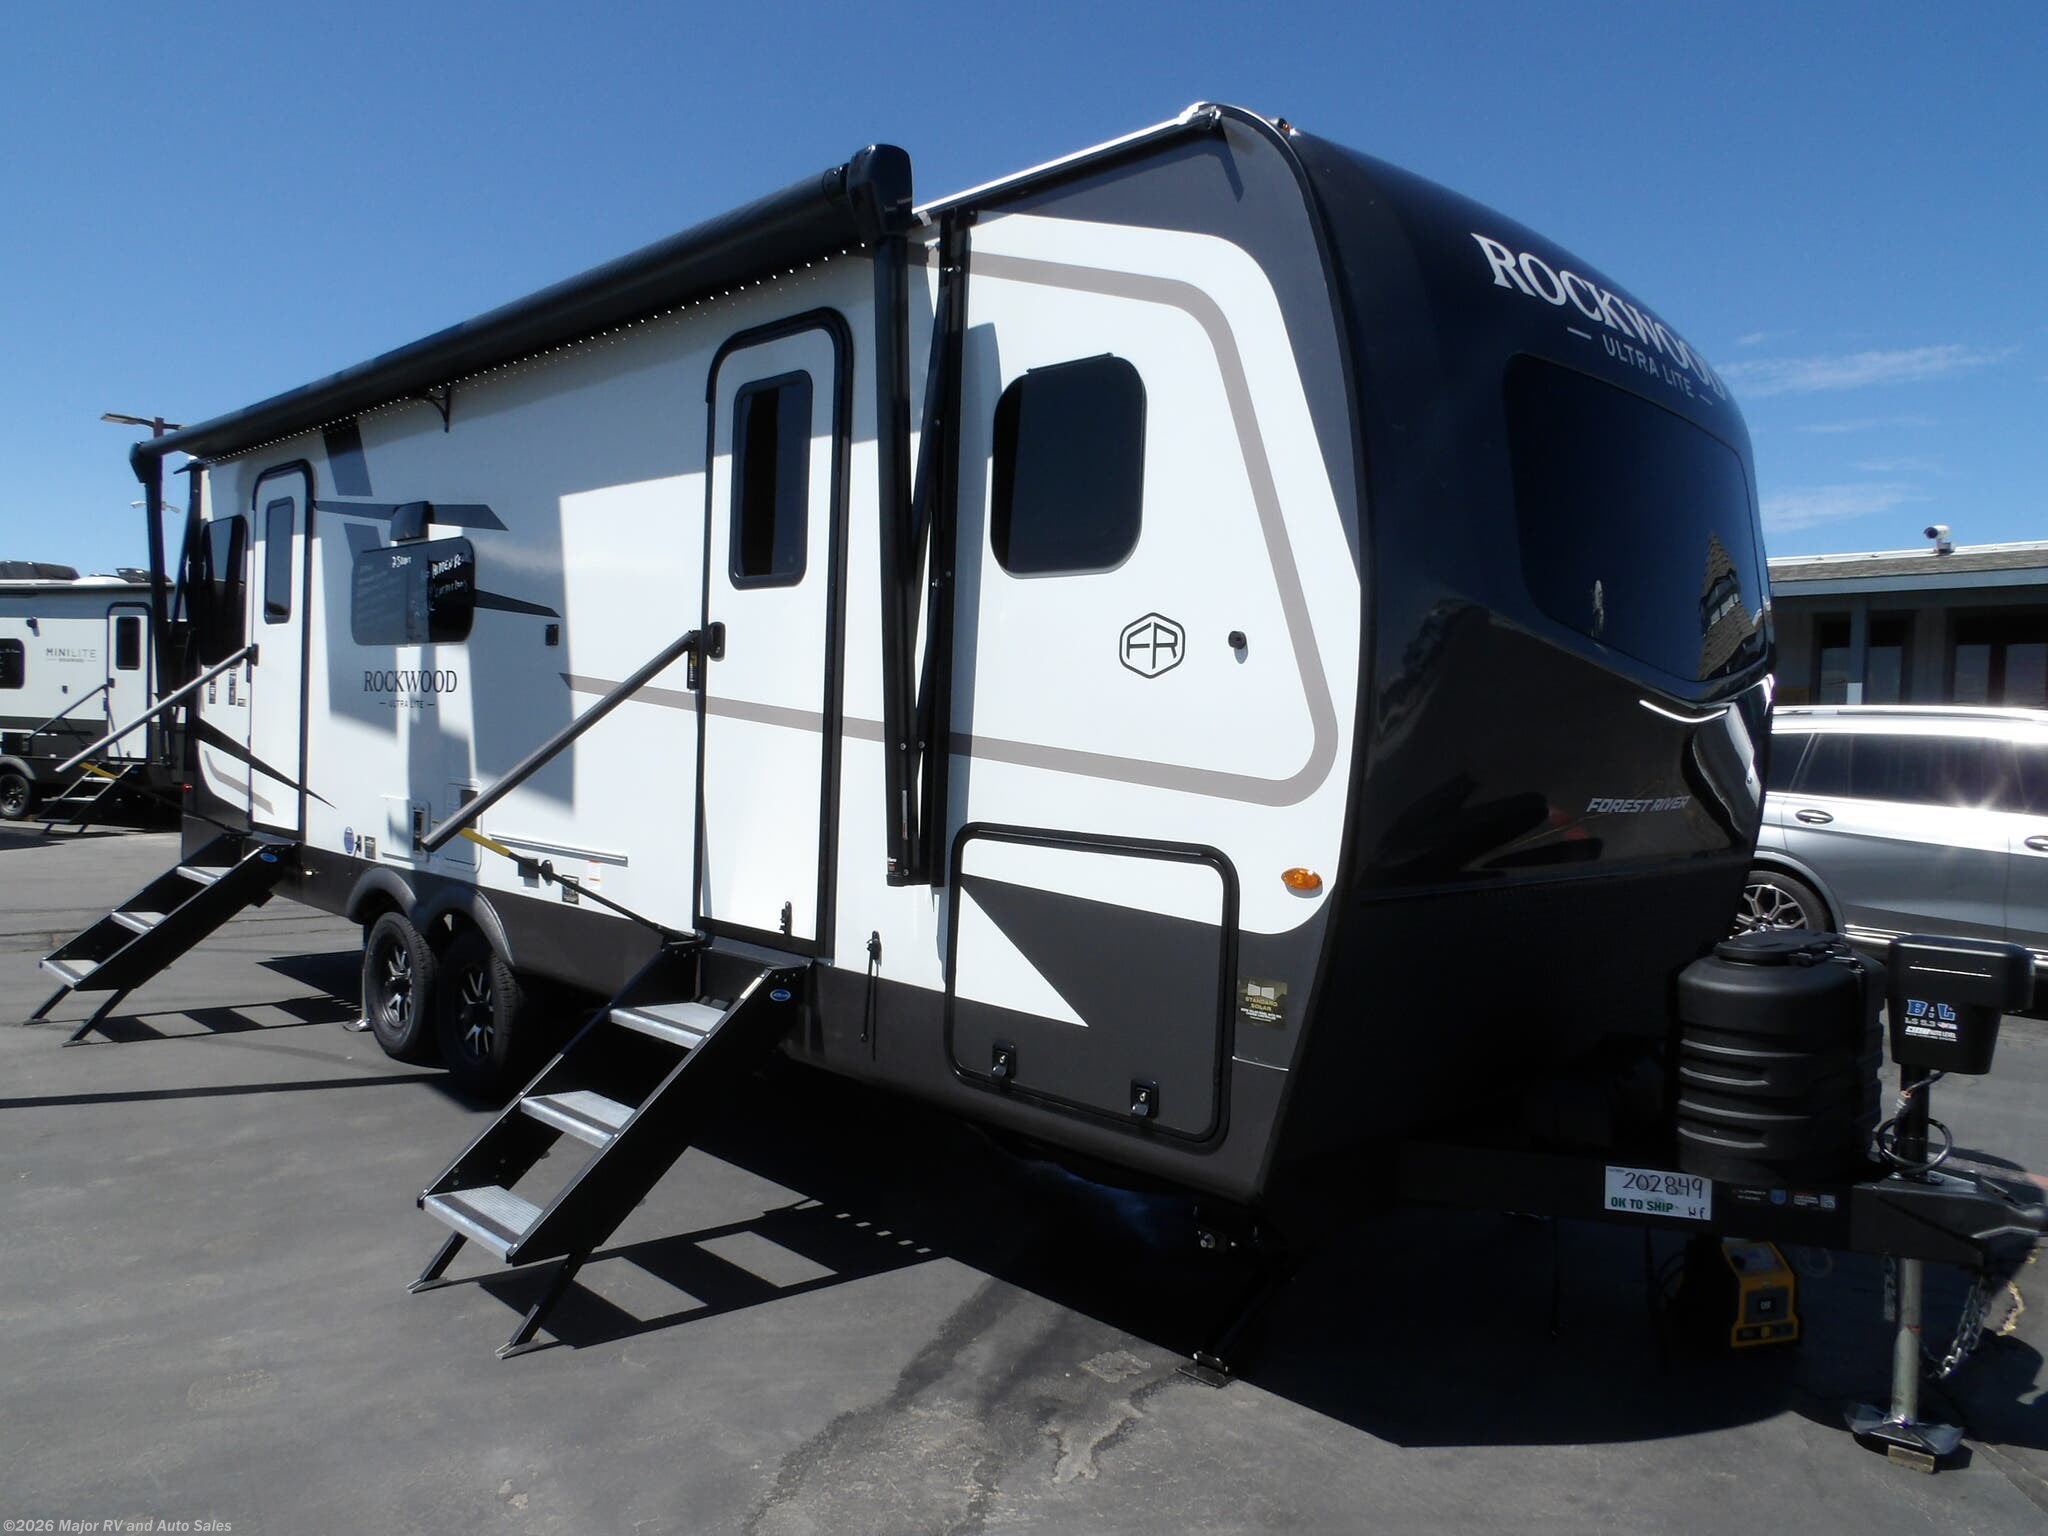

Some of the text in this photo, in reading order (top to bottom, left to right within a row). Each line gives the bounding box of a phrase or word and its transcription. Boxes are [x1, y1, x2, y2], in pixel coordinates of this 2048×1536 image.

[1602, 333, 1695, 398] ULTRA LITE
[363, 670, 457, 693] ROCKWOOD
[1586, 796, 1690, 813] FOREST RIVER
[1251, 1003, 1272, 1013] SOLAR
[1622, 1172, 1703, 1199] 202849
[1611, 1197, 1674, 1213] OK TO SHIP
